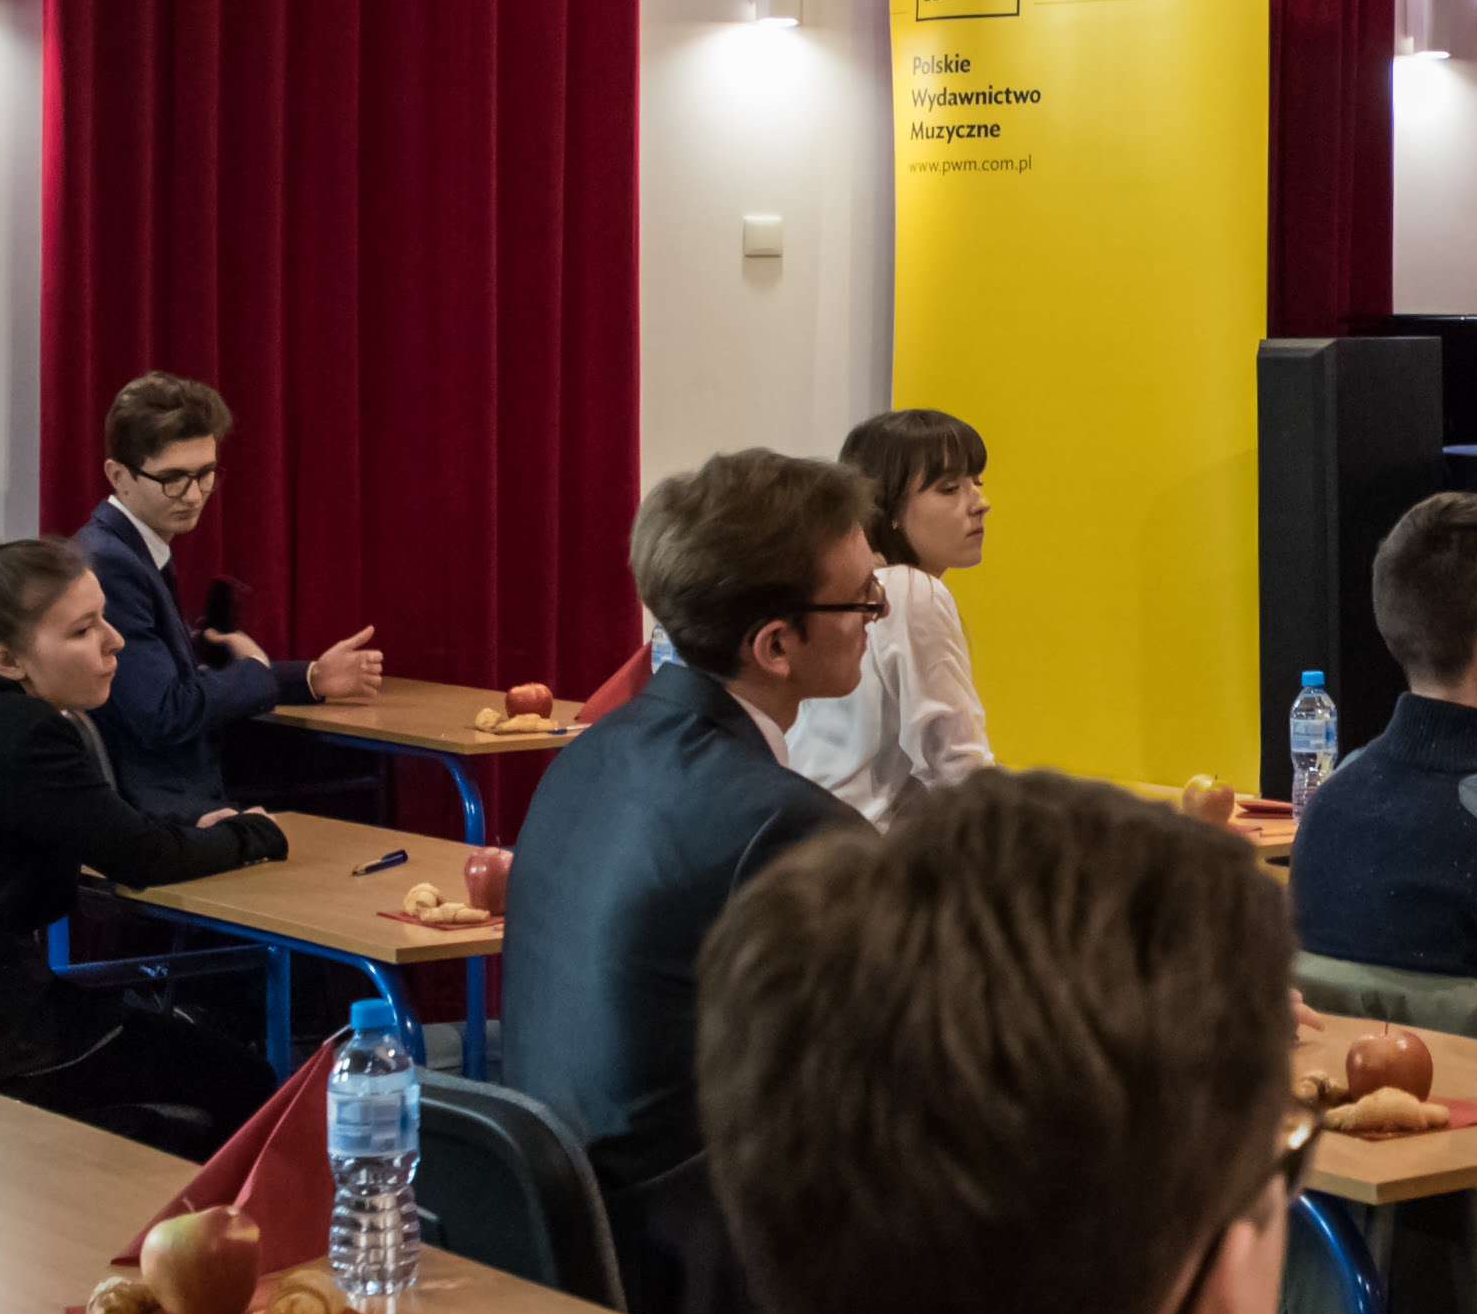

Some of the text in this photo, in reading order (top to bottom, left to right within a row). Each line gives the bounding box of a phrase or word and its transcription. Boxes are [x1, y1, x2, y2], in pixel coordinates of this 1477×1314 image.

[913, 53, 971, 75] Polskie
[911, 85, 1041, 112] Wydawnictwo
[910, 121, 1001, 144] Muzyczne
[909, 154, 1032, 175] www.pwm.com.pl
